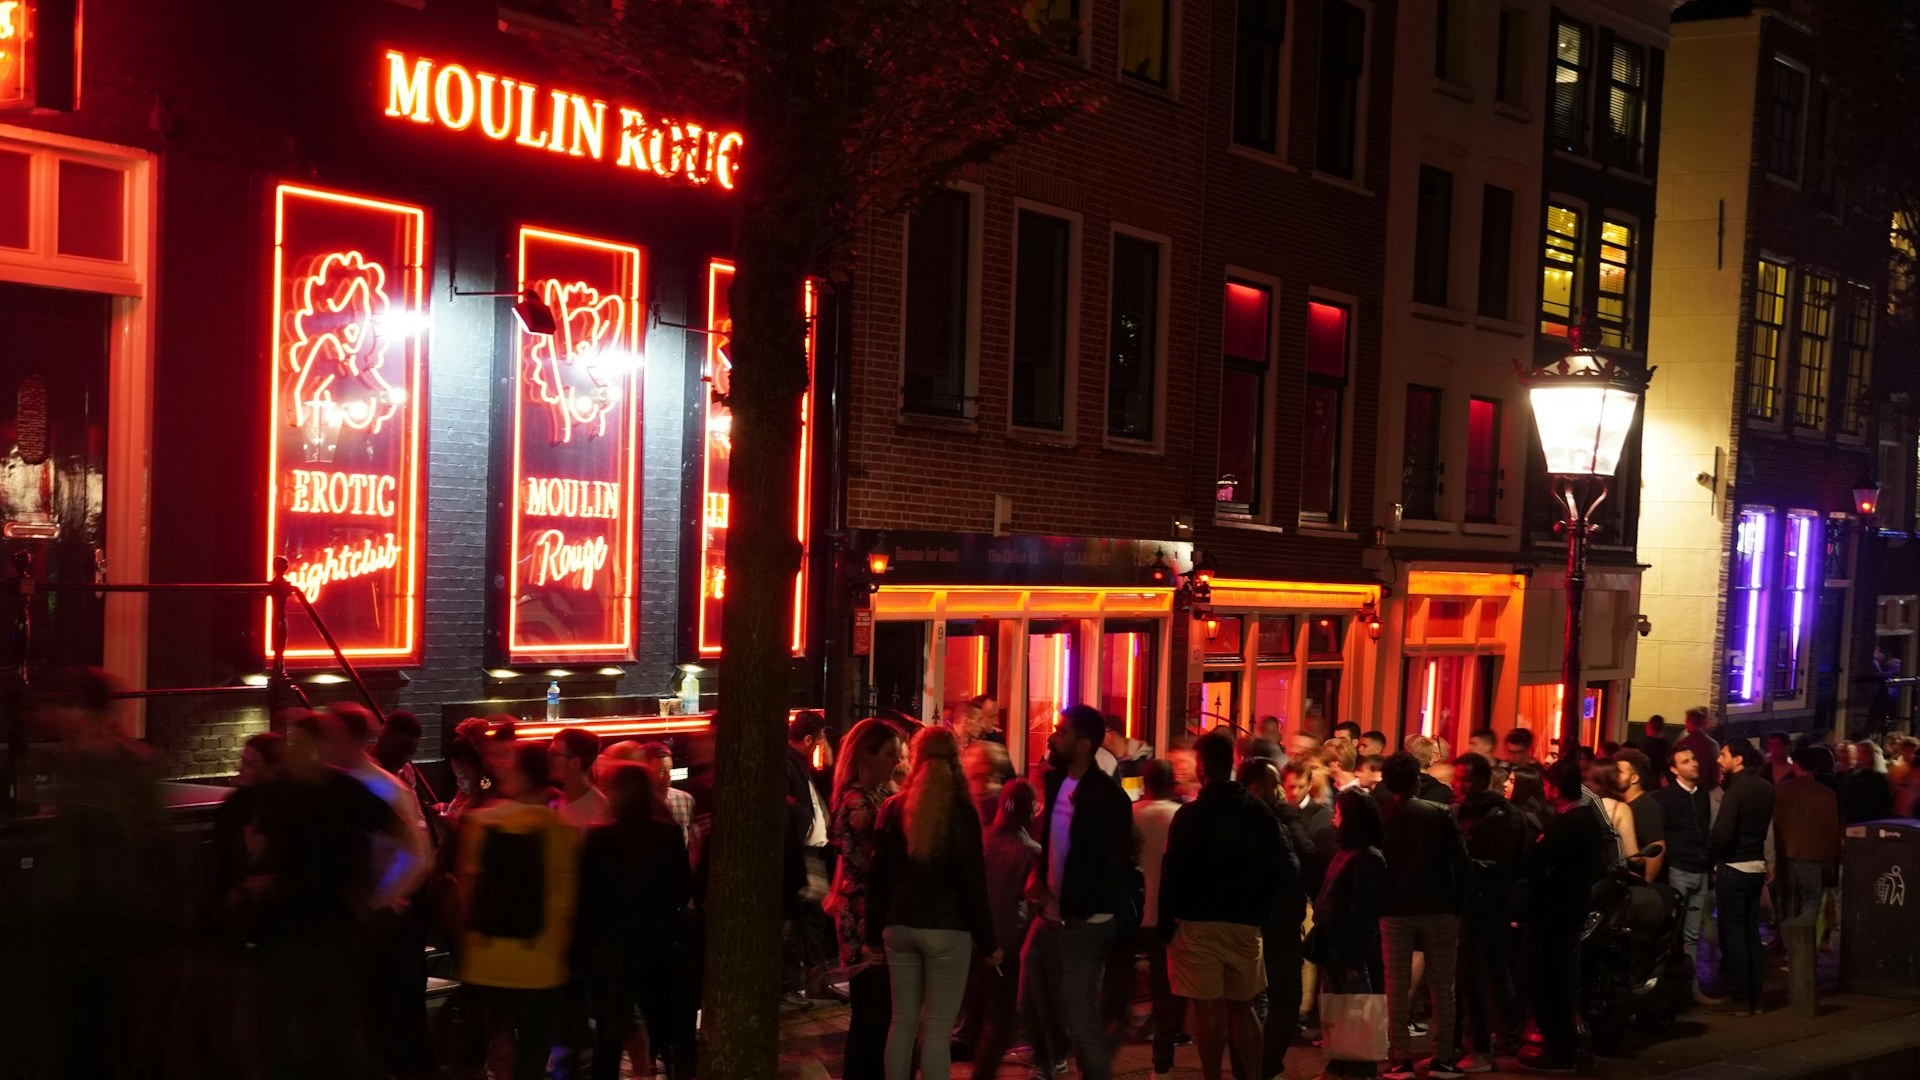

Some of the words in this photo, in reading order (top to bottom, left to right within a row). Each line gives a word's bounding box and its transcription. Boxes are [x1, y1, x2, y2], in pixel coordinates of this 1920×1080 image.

[385, 50, 606, 160] MOULIN
[616, 107, 743, 189] ROUG
[291, 469, 396, 518] EROTIC
[525, 477, 620, 520] MOULIN
[537, 529, 608, 592] Rouge
[937, 626, 944, 640] 9
